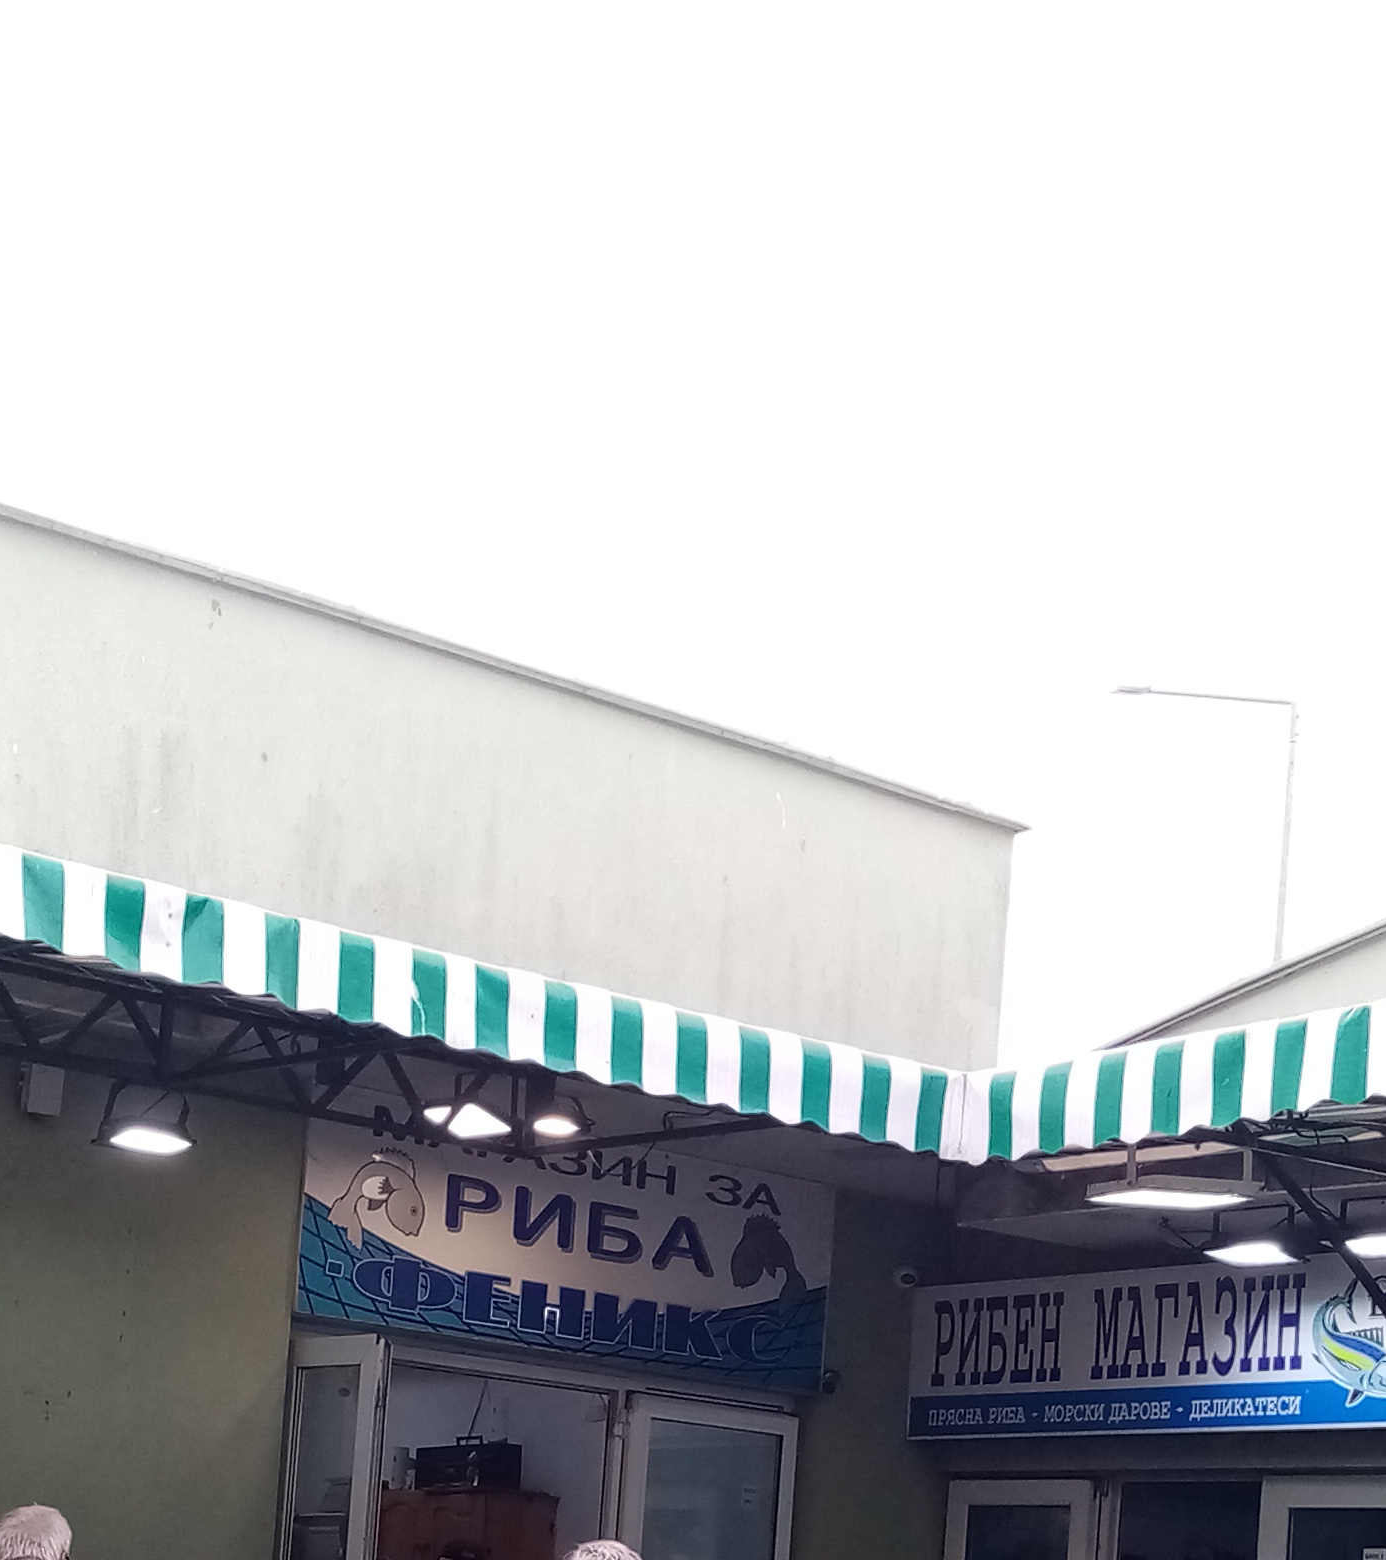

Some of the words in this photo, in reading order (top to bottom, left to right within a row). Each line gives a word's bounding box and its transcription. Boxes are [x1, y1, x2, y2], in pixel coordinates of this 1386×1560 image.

[444, 1172, 715, 1278] РИБА
[706, 1174, 782, 1217] ЗА
[352, 1255, 787, 1366] ФЕНИКС
[930, 1289, 1065, 1388] РИБЕН
[1091, 1272, 1306, 1381] МАГАЗИН
[928, 1409, 983, 1427] ПРЯСНА
[987, 1407, 1025, 1425] РИБА
[1043, 1405, 1104, 1424] МОРСКИ
[1108, 1401, 1171, 1424] ДАРОВЕ
[1189, 1395, 1302, 1422] ДЕЛИКАТЕСИ
